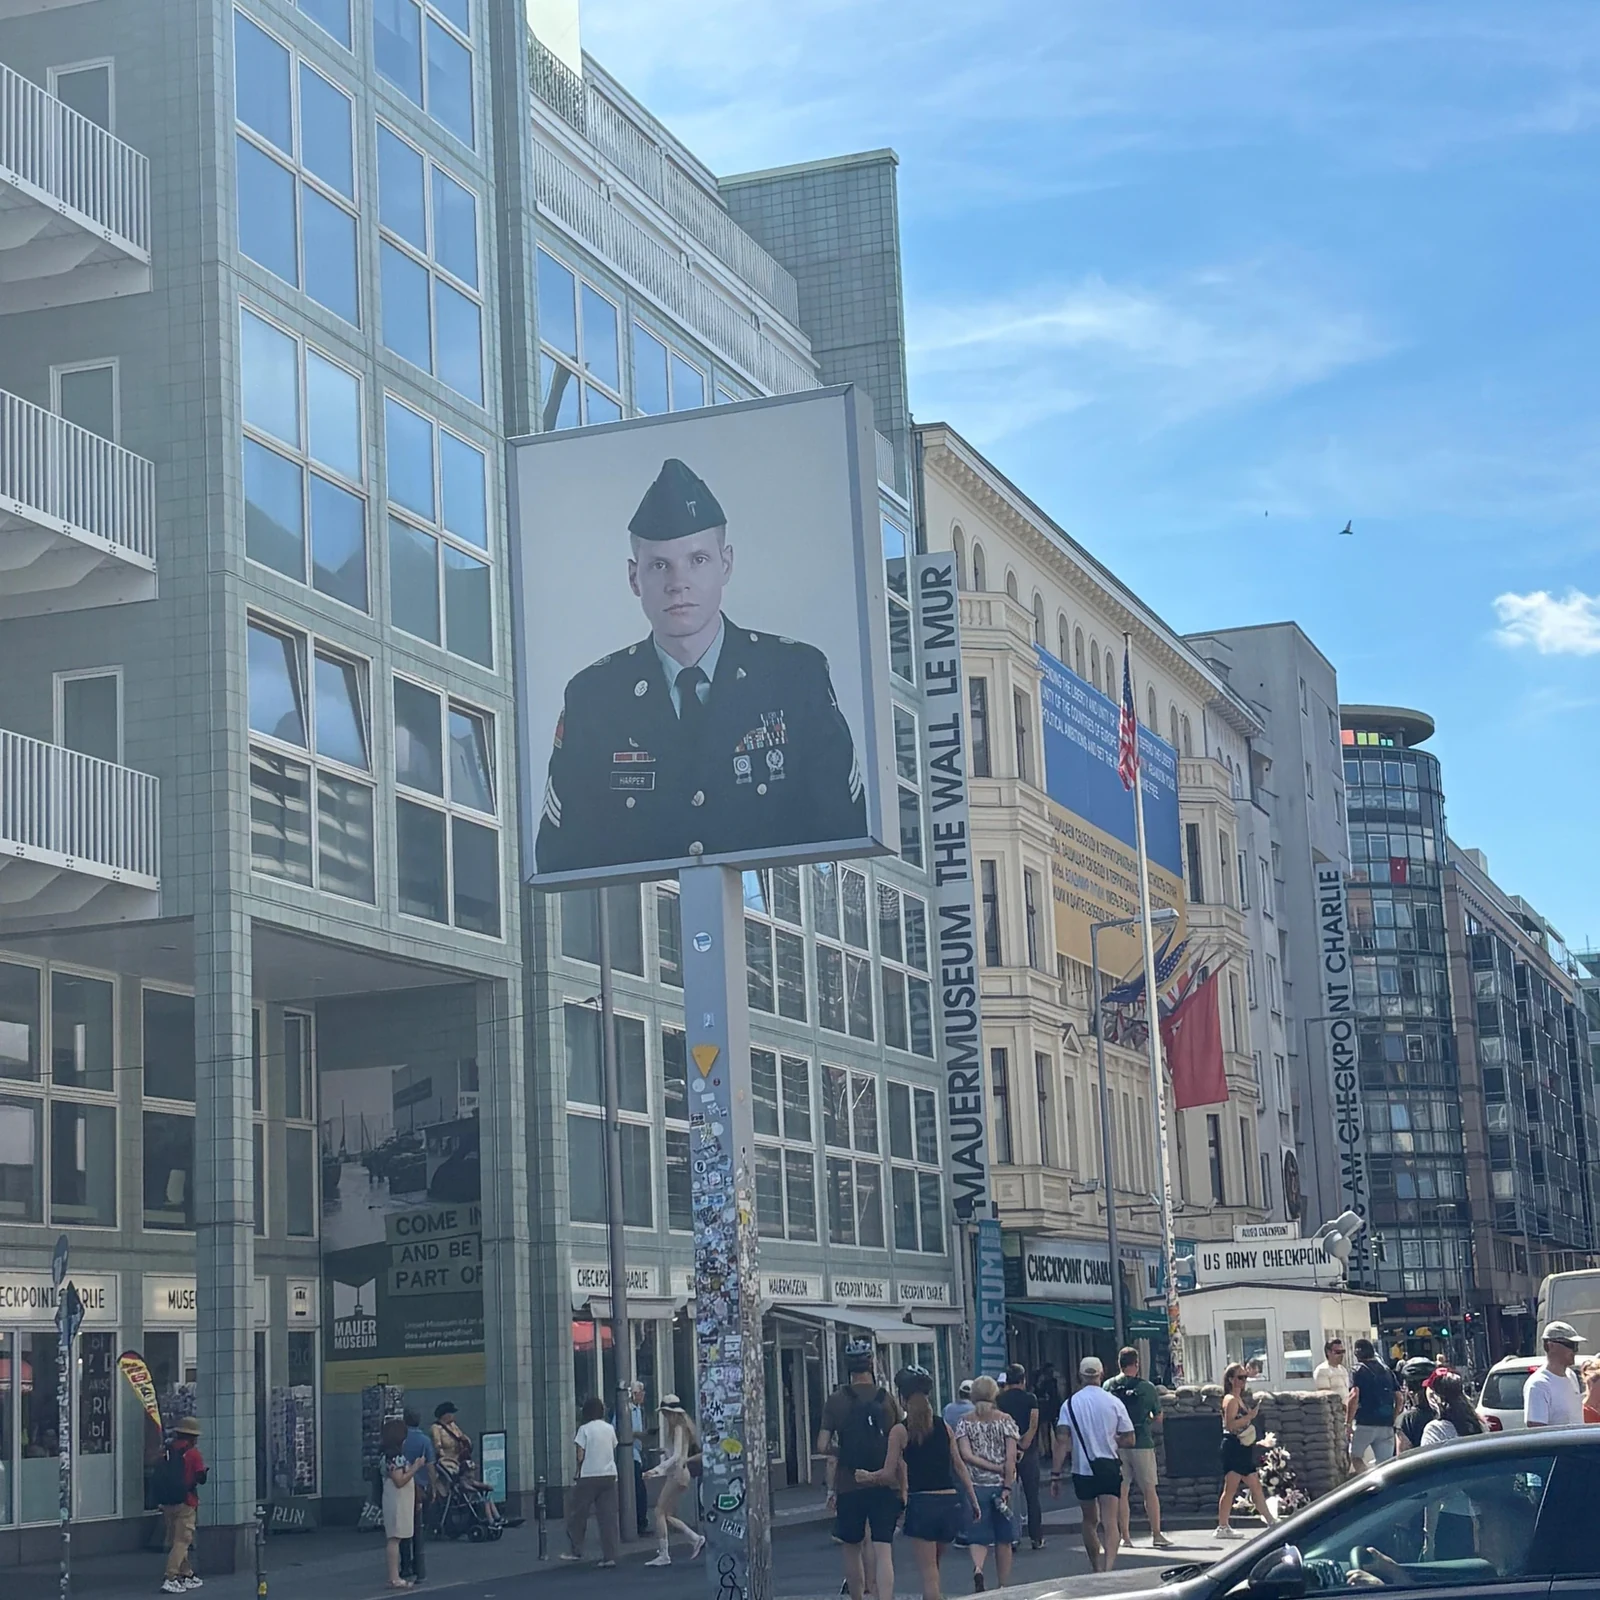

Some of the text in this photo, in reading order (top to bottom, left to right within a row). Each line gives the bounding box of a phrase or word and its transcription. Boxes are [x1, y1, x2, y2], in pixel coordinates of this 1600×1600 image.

[920, 565, 987, 1208] MAUERMUSEUM THE WALL LE MUR
[1319, 870, 1347, 974] CHARLIE
[396, 1210, 458, 1236] COME
[401, 1240, 472, 1263] AND BE
[1203, 1253, 1220, 1271] US
[1226, 1251, 1257, 1270] ARMY
[396, 1269, 449, 1289] PART
[1027, 1254, 1082, 1285] CHECKPOINT
[168, 1289, 196, 1309] MUSE
[334, 1319, 377, 1336] MAUER
[334, 1335, 377, 1349] MUSEUM
